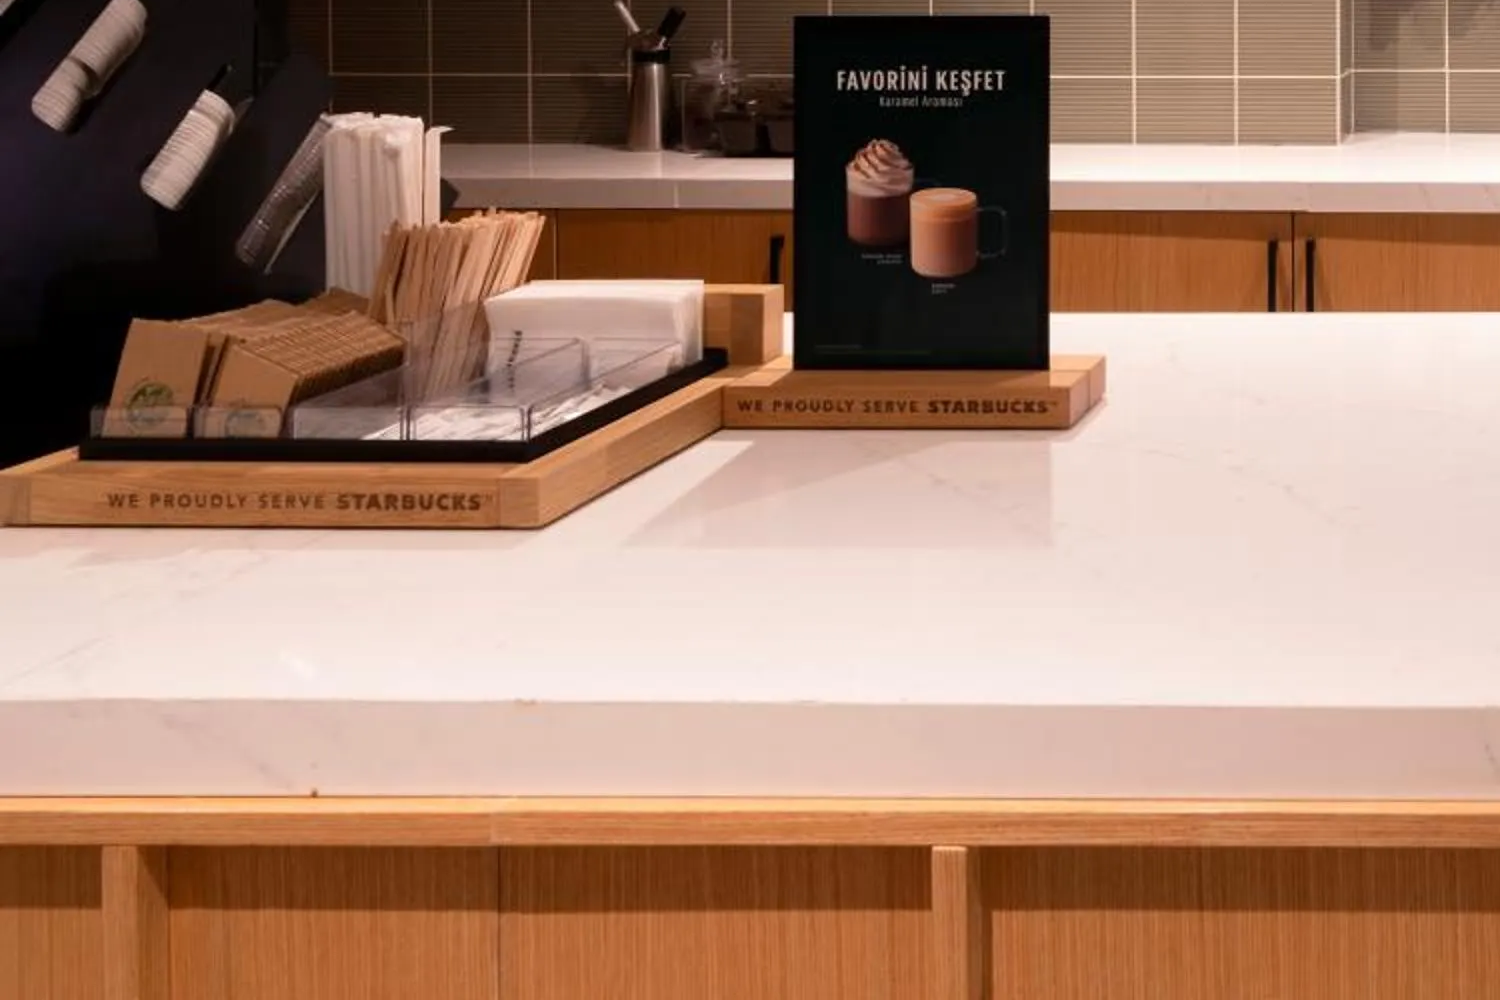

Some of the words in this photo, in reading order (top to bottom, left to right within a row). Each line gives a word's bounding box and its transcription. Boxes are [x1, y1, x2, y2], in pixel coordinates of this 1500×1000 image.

[836, 65, 929, 92] FAVORİNİ
[936, 70, 1006, 97] KEŞFET
[878, 95, 919, 108] Karamel
[922, 95, 964, 108] Aroması
[737, 400, 763, 413] WE
[772, 400, 854, 414] PROUDLY
[863, 400, 920, 414] SERVE
[927, 400, 1049, 414] STARBUCKS
[108, 493, 140, 509] WE
[150, 493, 248, 510] PROUDLY
[259, 493, 325, 510] SERVE
[336, 493, 483, 511] STARBUCKS
